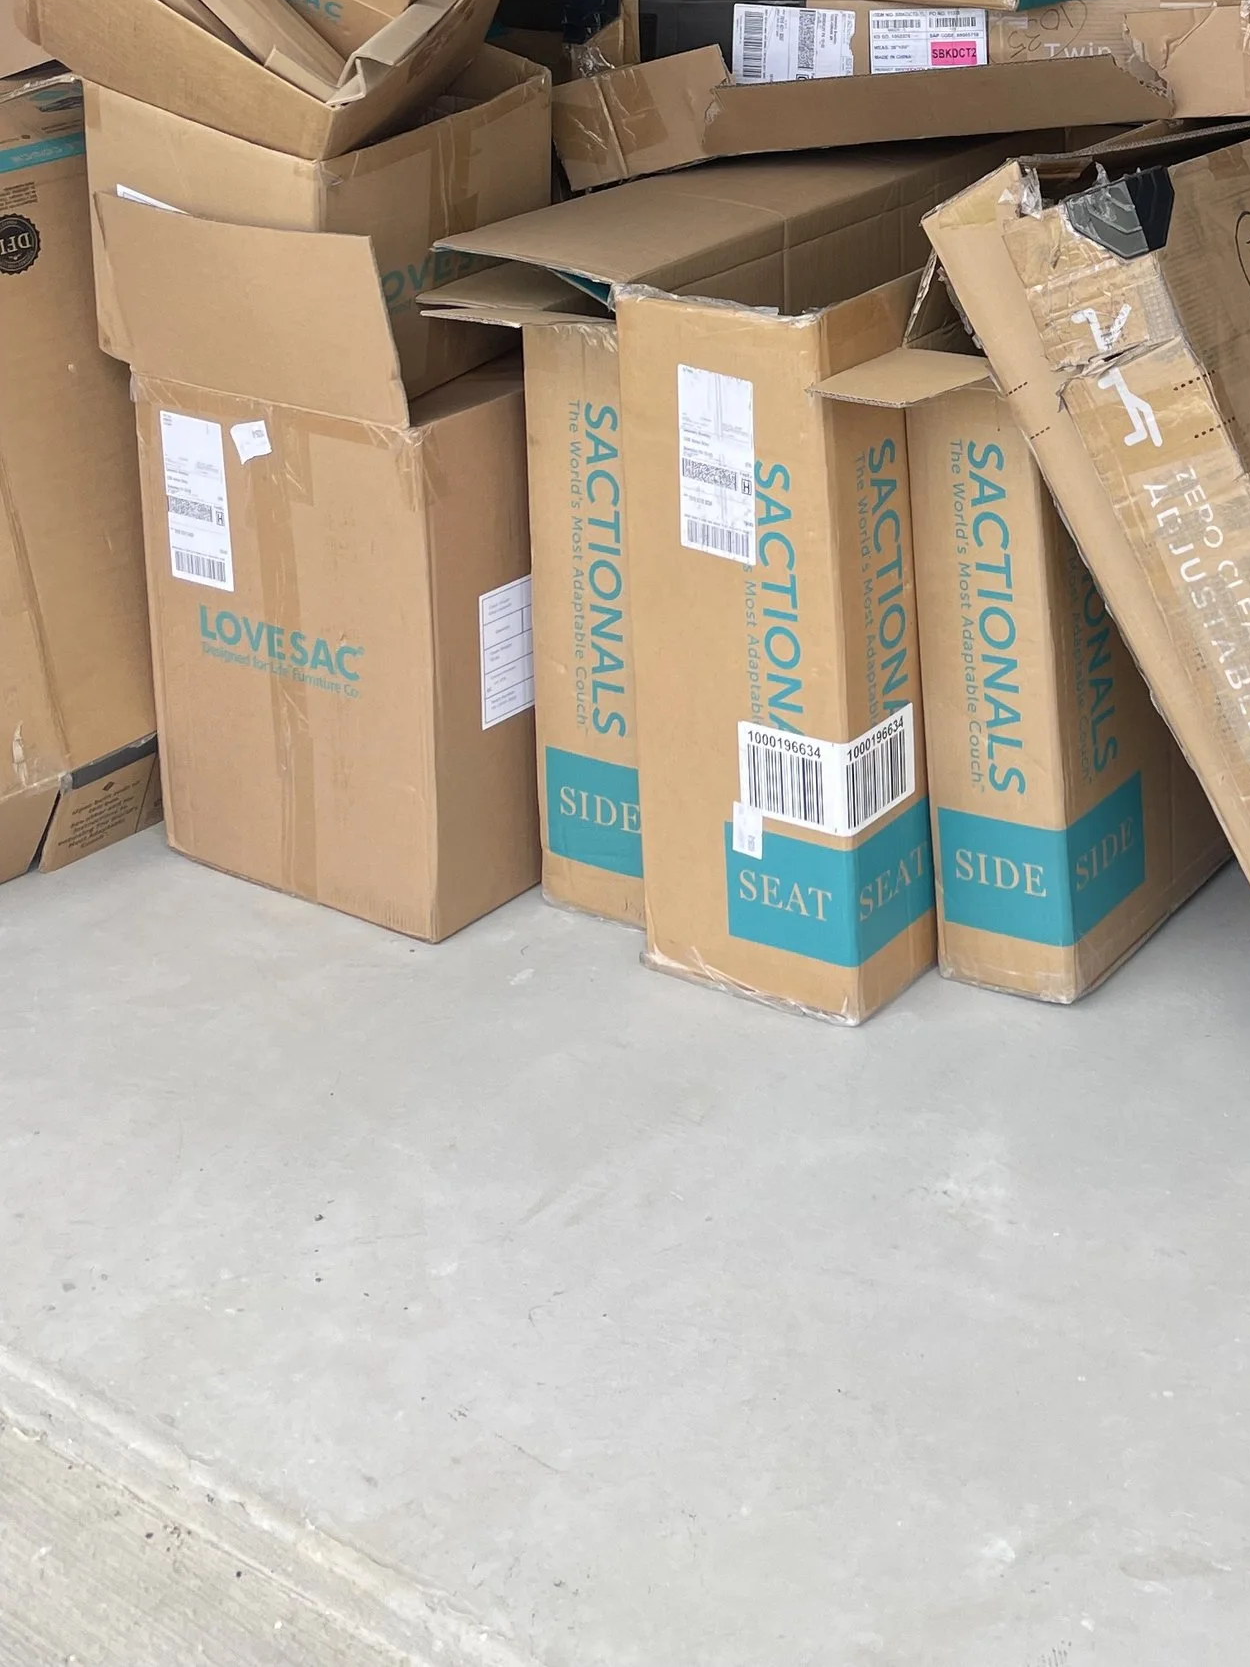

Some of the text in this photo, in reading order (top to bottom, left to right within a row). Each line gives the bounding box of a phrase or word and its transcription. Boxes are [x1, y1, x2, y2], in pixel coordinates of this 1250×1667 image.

[932, 47, 977, 59] SBKDCT2
[568, 399, 580, 432] The
[569, 439, 582, 509] World's
[950, 439, 964, 475] The
[954, 482, 969, 556] World's
[1176, 466, 1223, 549] ZERO
[572, 515, 584, 564] Most
[855, 455, 874, 628] The World's Most
[584, 400, 627, 738] SACTIONALS
[958, 562, 971, 610] Most
[572, 568, 587, 659] Adaptable
[744, 580, 756, 628] Most
[968, 439, 1026, 795] SACTIONALS
[199, 604, 362, 682] LOVESAC
[202, 640, 343, 694] Designed for Life Furniture
[960, 615, 978, 713] Adaptable
[747, 730, 821, 759] 1000196634
[846, 717, 904, 762] 1000196634
[559, 786, 641, 835] SIDE
[859, 841, 928, 922] SEAT
[955, 847, 1048, 898] SIDE
[1075, 818, 1135, 892] SIDE
[739, 869, 833, 922] SEAT
